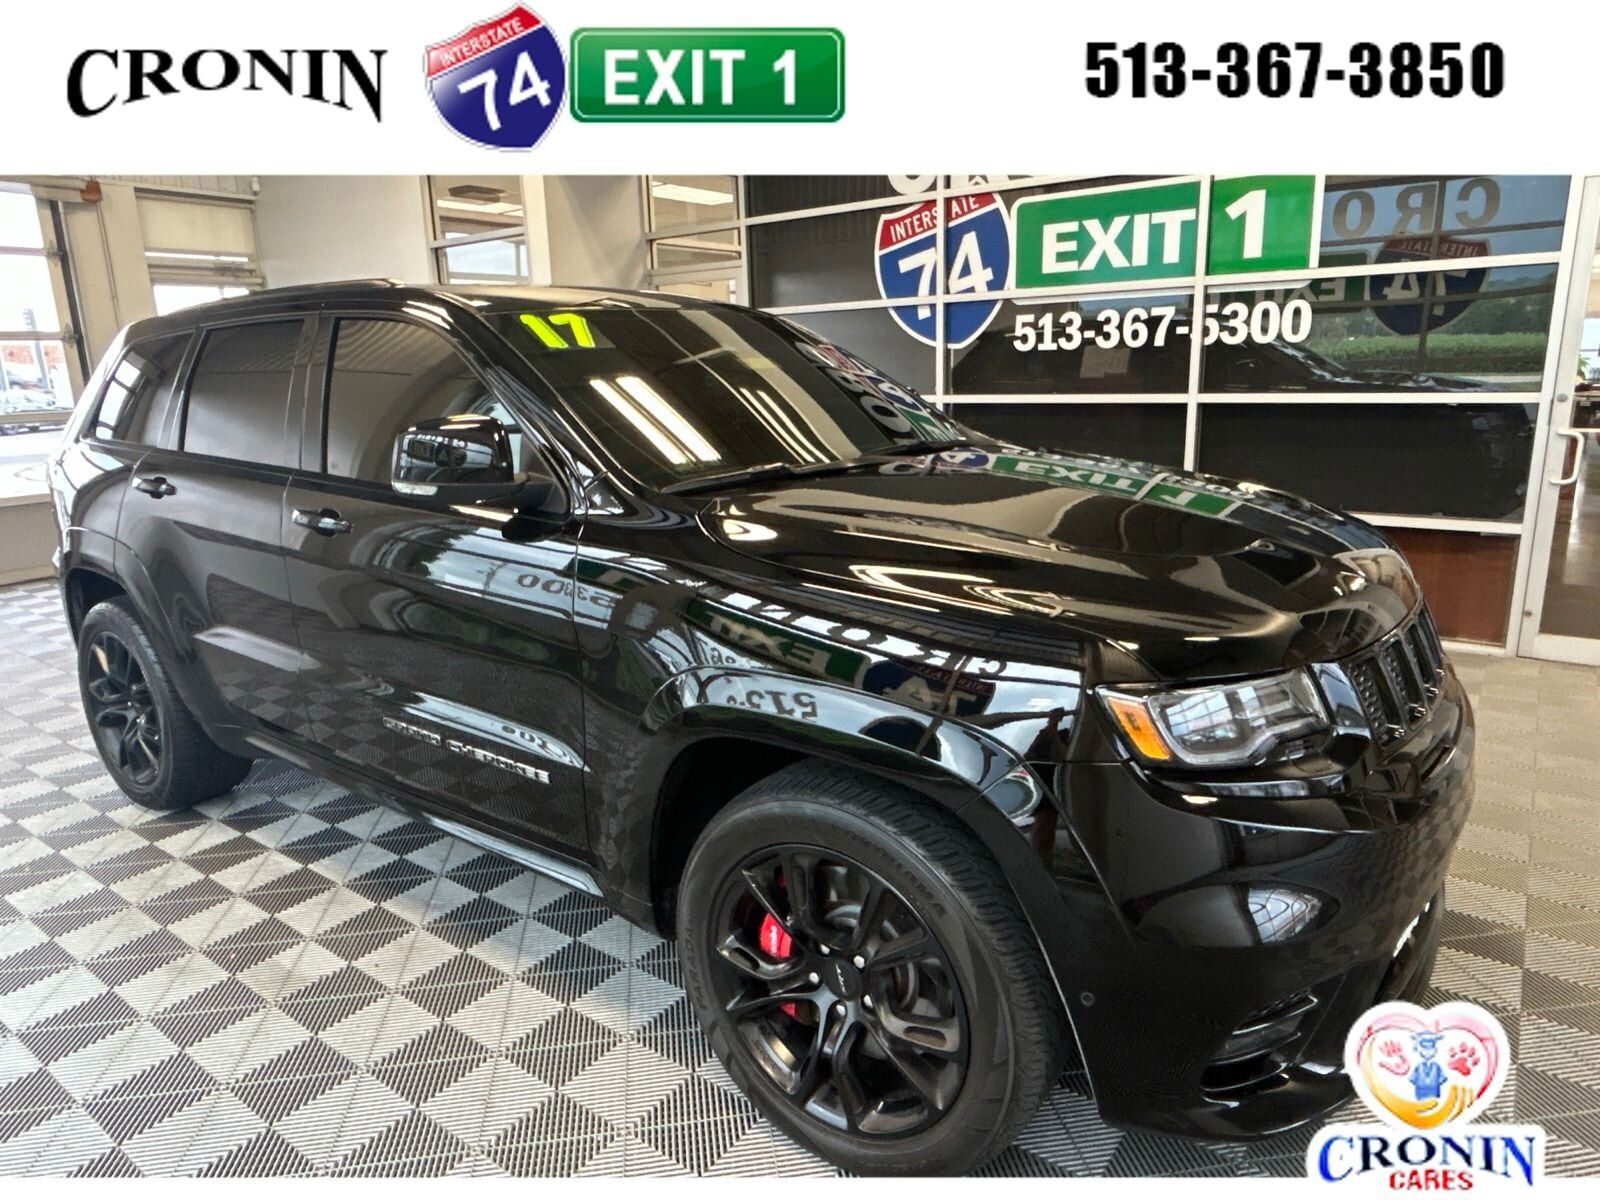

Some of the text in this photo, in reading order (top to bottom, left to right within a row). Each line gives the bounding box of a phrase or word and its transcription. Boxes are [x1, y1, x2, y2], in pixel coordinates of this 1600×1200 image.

[890, 194, 979, 243] INTERSATE
[1042, 189, 1266, 274] EXIT 1
[898, 231, 993, 320] 74
[520, 313, 596, 348] 17
[1013, 299, 1312, 353] 513-367-5300
